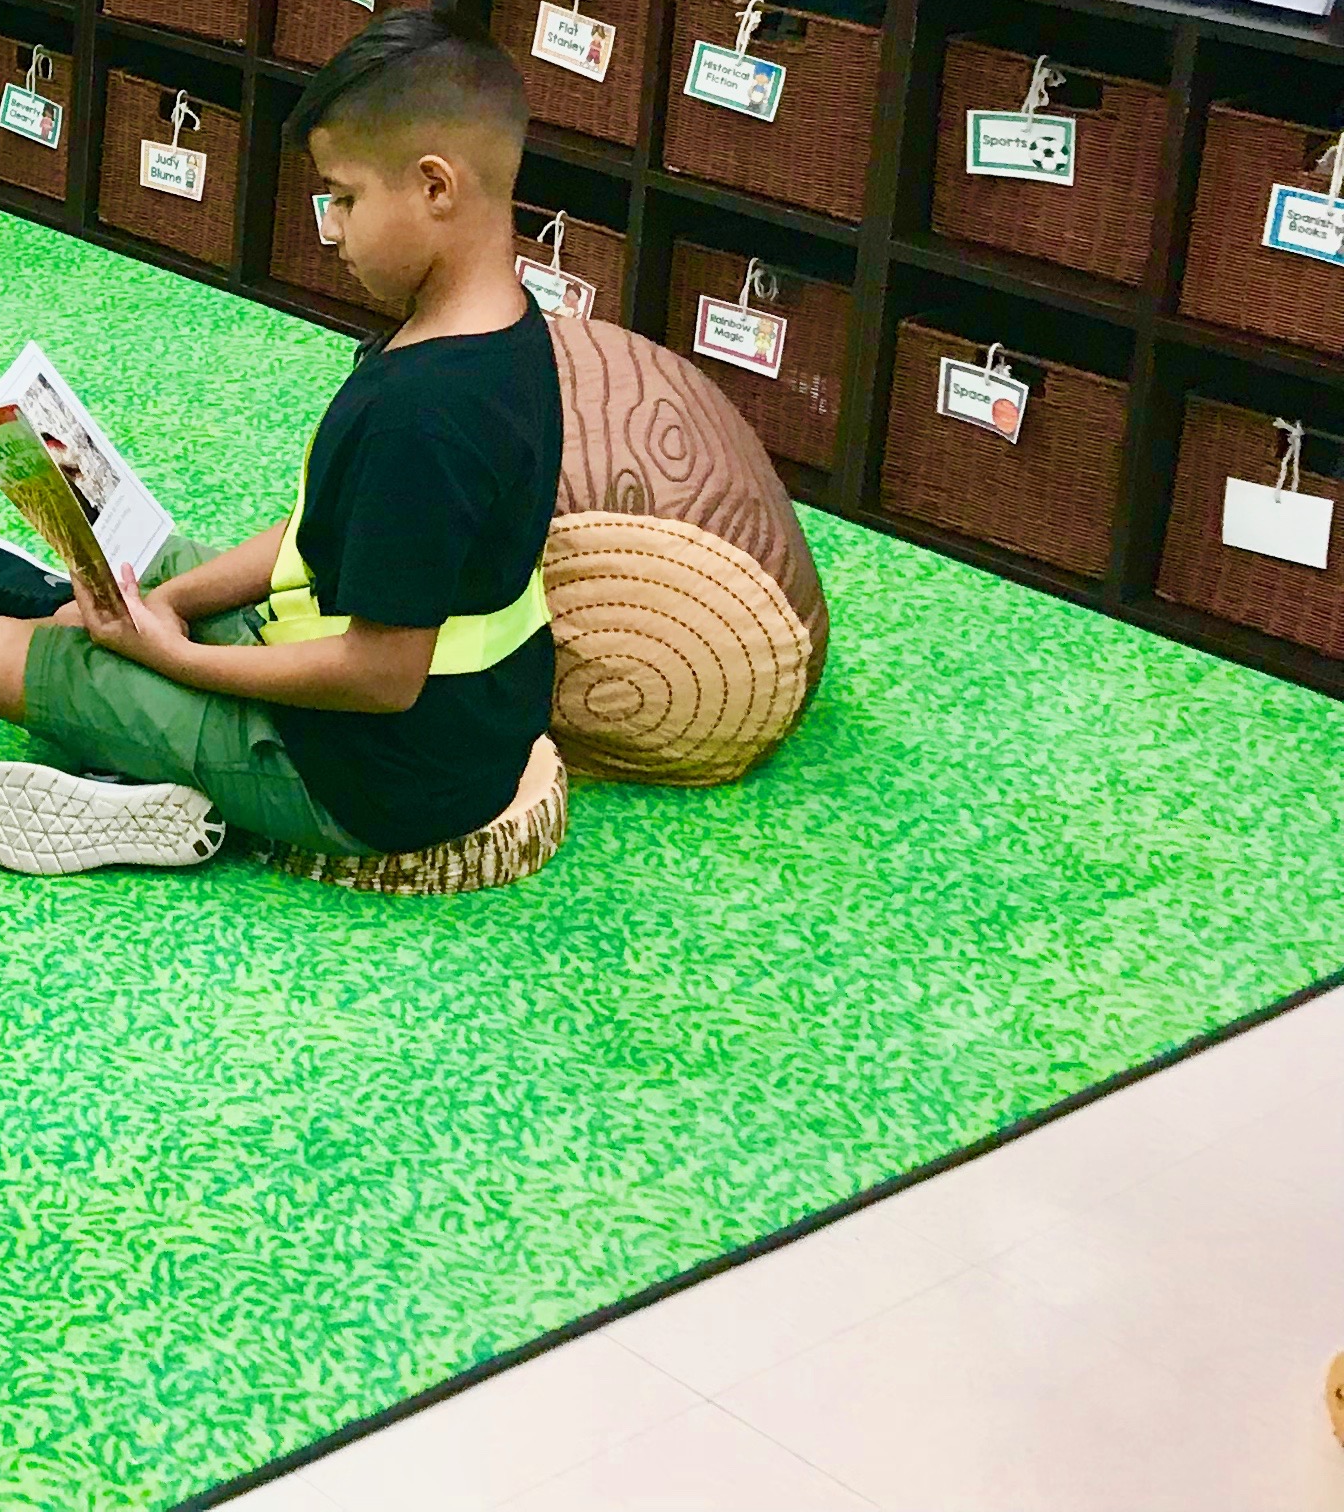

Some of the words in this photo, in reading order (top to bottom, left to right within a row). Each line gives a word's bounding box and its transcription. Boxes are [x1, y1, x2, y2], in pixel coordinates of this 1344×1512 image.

[558, 21, 579, 36] Flat
[547, 31, 585, 55] Stanley
[703, 59, 750, 81] Historical
[706, 72, 738, 90] Fiction
[10, 109, 35, 125] Cleary
[11, 98, 40, 117] Beverly
[982, 134, 1027, 148] Sports
[155, 153, 179, 170] Judy
[150, 168, 182, 184] Blume
[1286, 209, 1334, 229] Spanish
[1289, 220, 1328, 239] Books
[524, 279, 562, 299] Biography
[709, 313, 751, 332] Rainbow
[714, 326, 744, 343] Magic
[953, 382, 991, 404] Space
